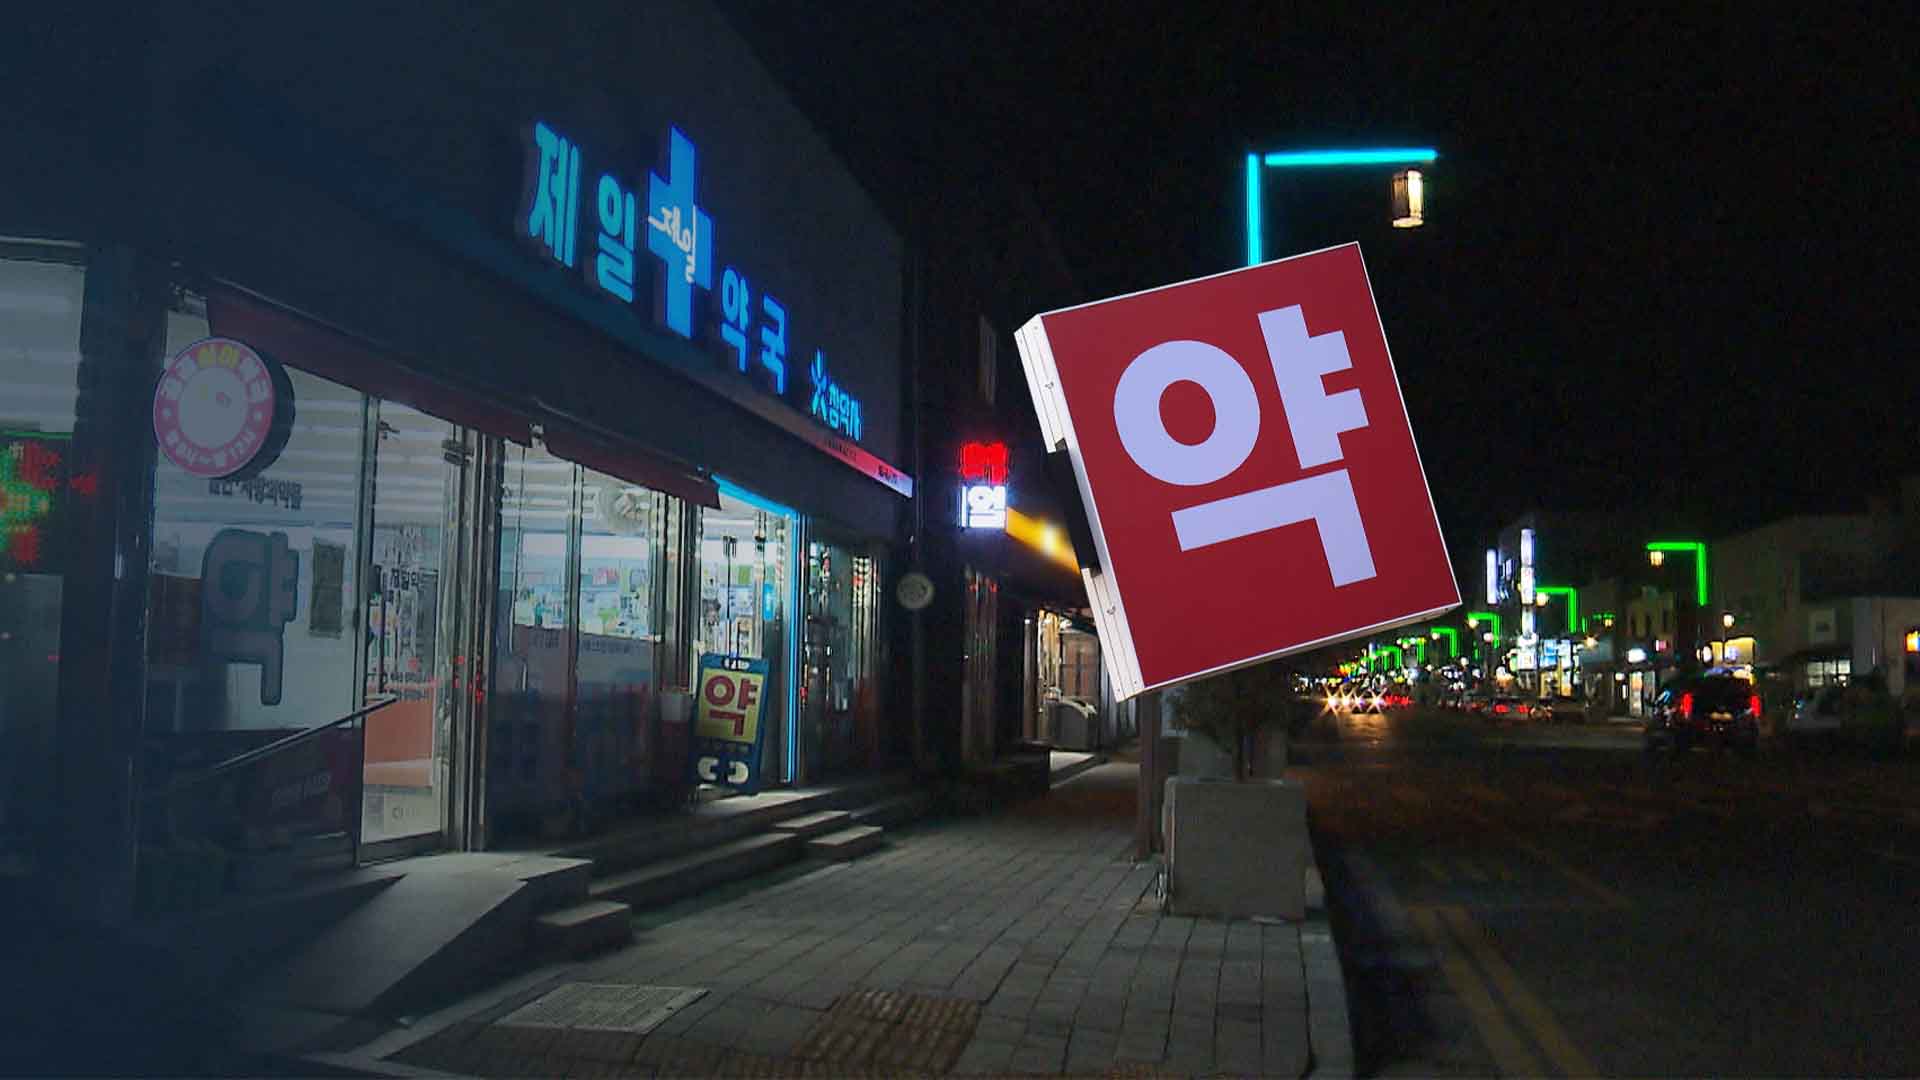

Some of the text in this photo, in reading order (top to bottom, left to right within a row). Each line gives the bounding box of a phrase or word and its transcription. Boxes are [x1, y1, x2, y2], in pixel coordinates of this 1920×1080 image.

[528, 120, 790, 395] 제일 약국
[1113, 303, 1378, 588] 약
[201, 527, 300, 707] 약
[704, 675, 758, 737] 약
